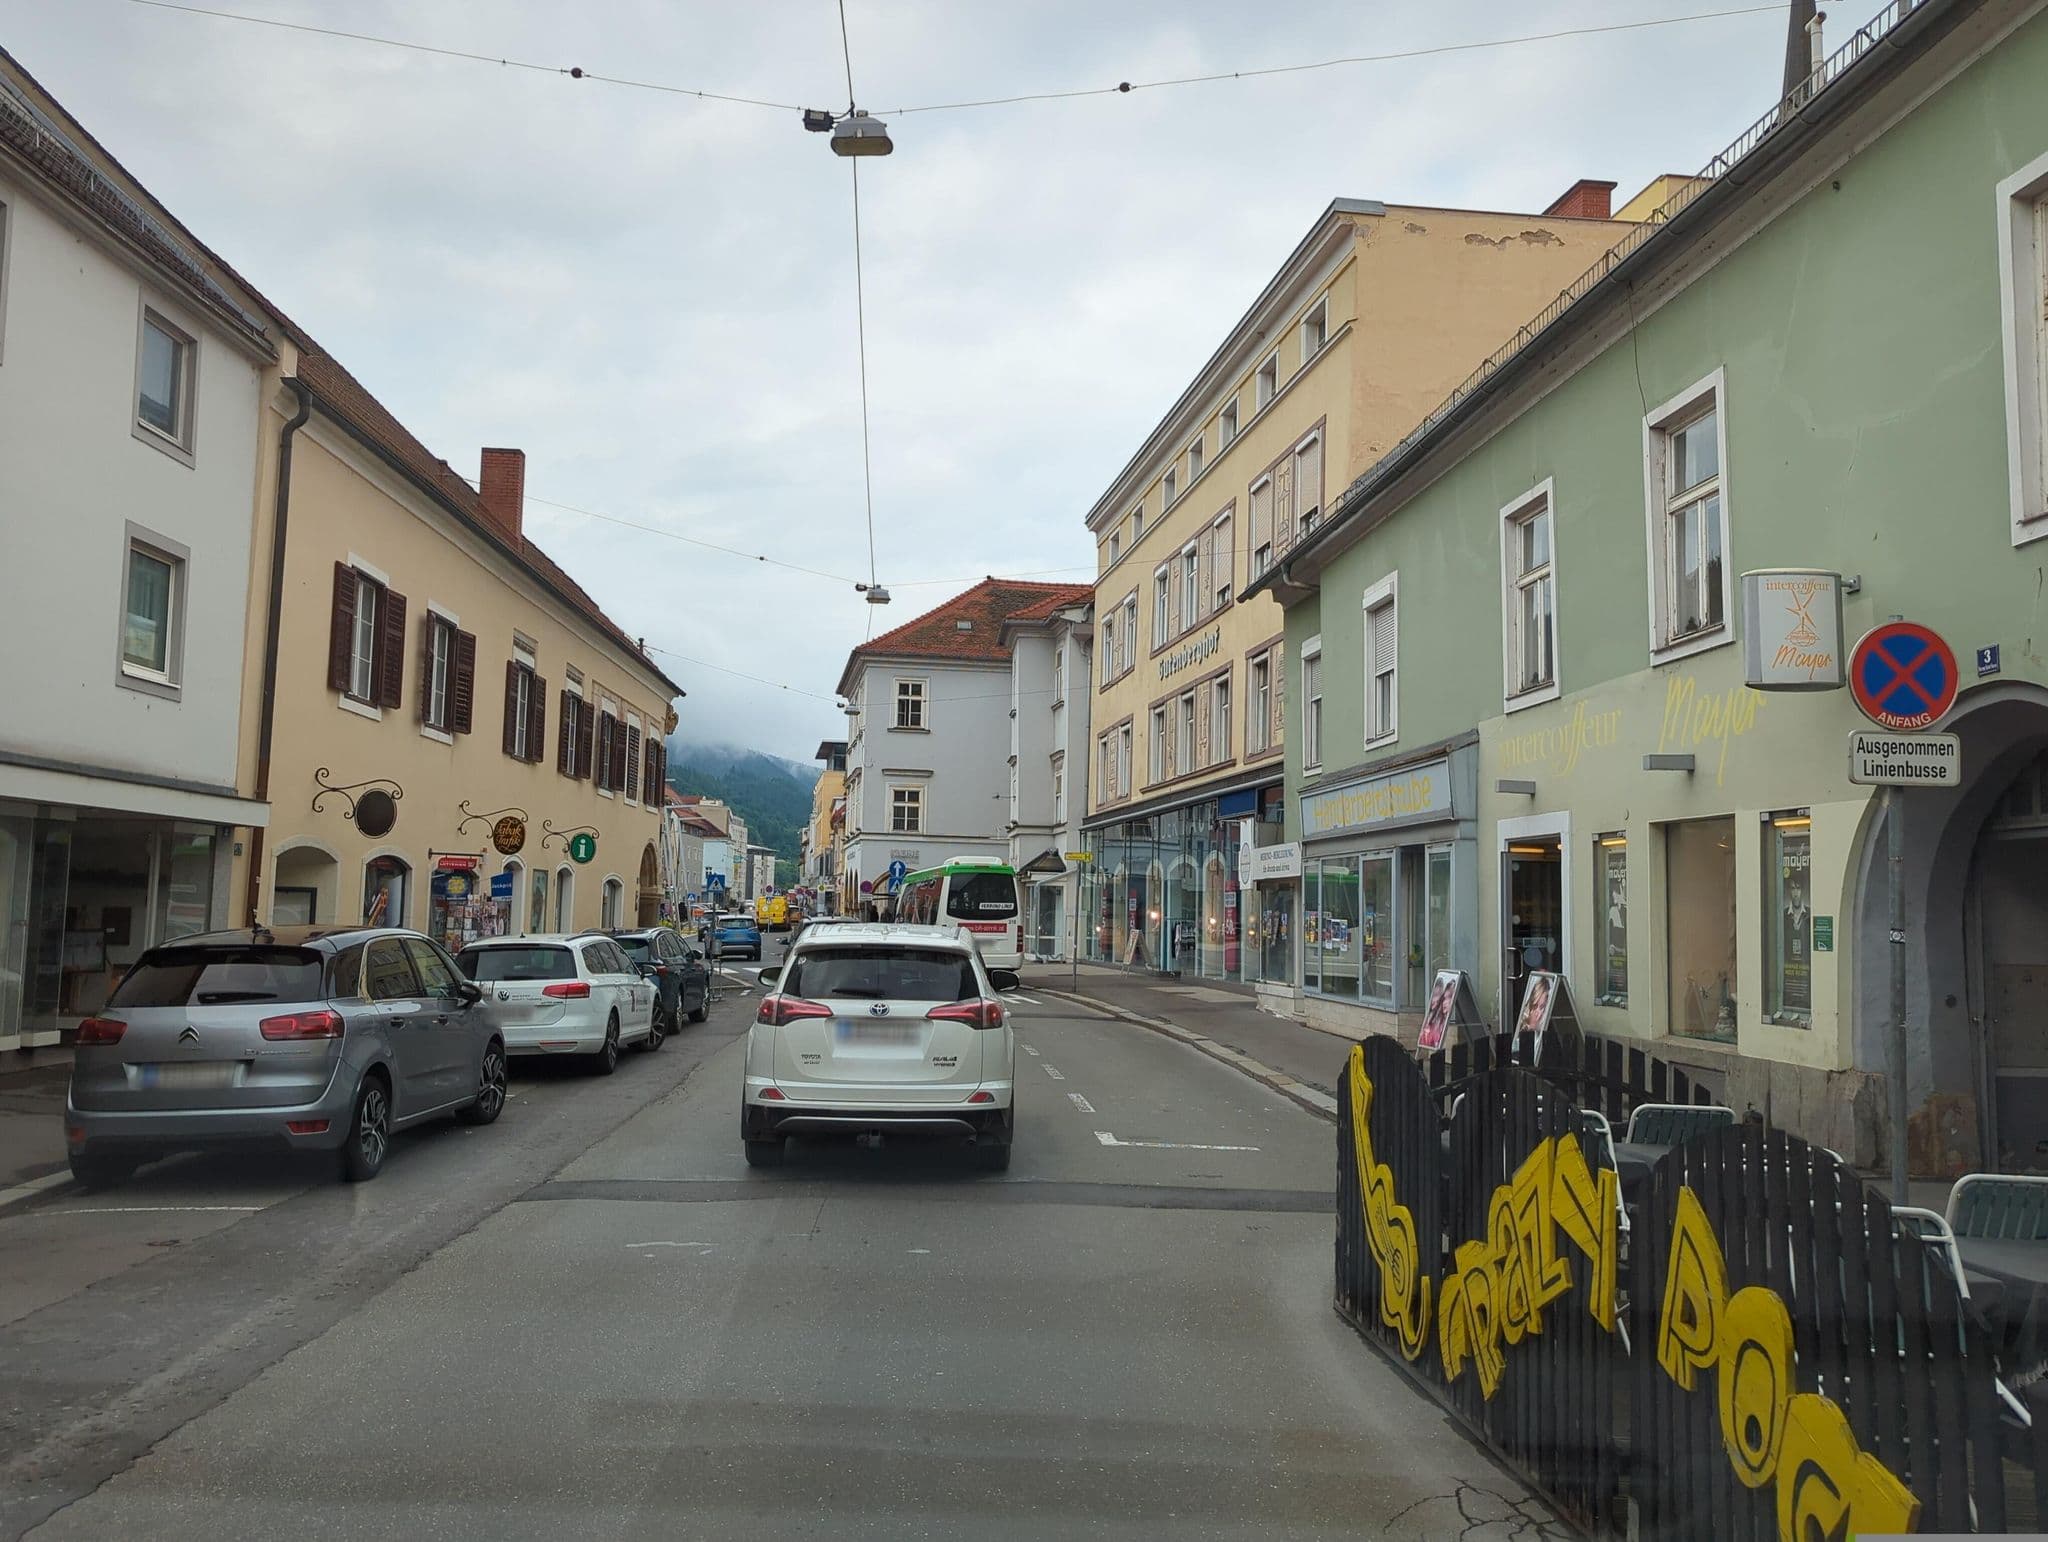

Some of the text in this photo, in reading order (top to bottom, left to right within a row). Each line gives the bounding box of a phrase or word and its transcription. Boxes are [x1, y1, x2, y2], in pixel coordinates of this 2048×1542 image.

[1766, 578, 1831, 594] intercoiffeur
[1771, 644, 1832, 680] Mayer
[1983, 649, 1992, 664] 3
[1877, 711, 1932, 728] ANFANG
[1658, 674, 1767, 788] Mayer
[1856, 736, 1954, 758] Ausgenommen
[1863, 759, 1947, 779] Linienbusse
